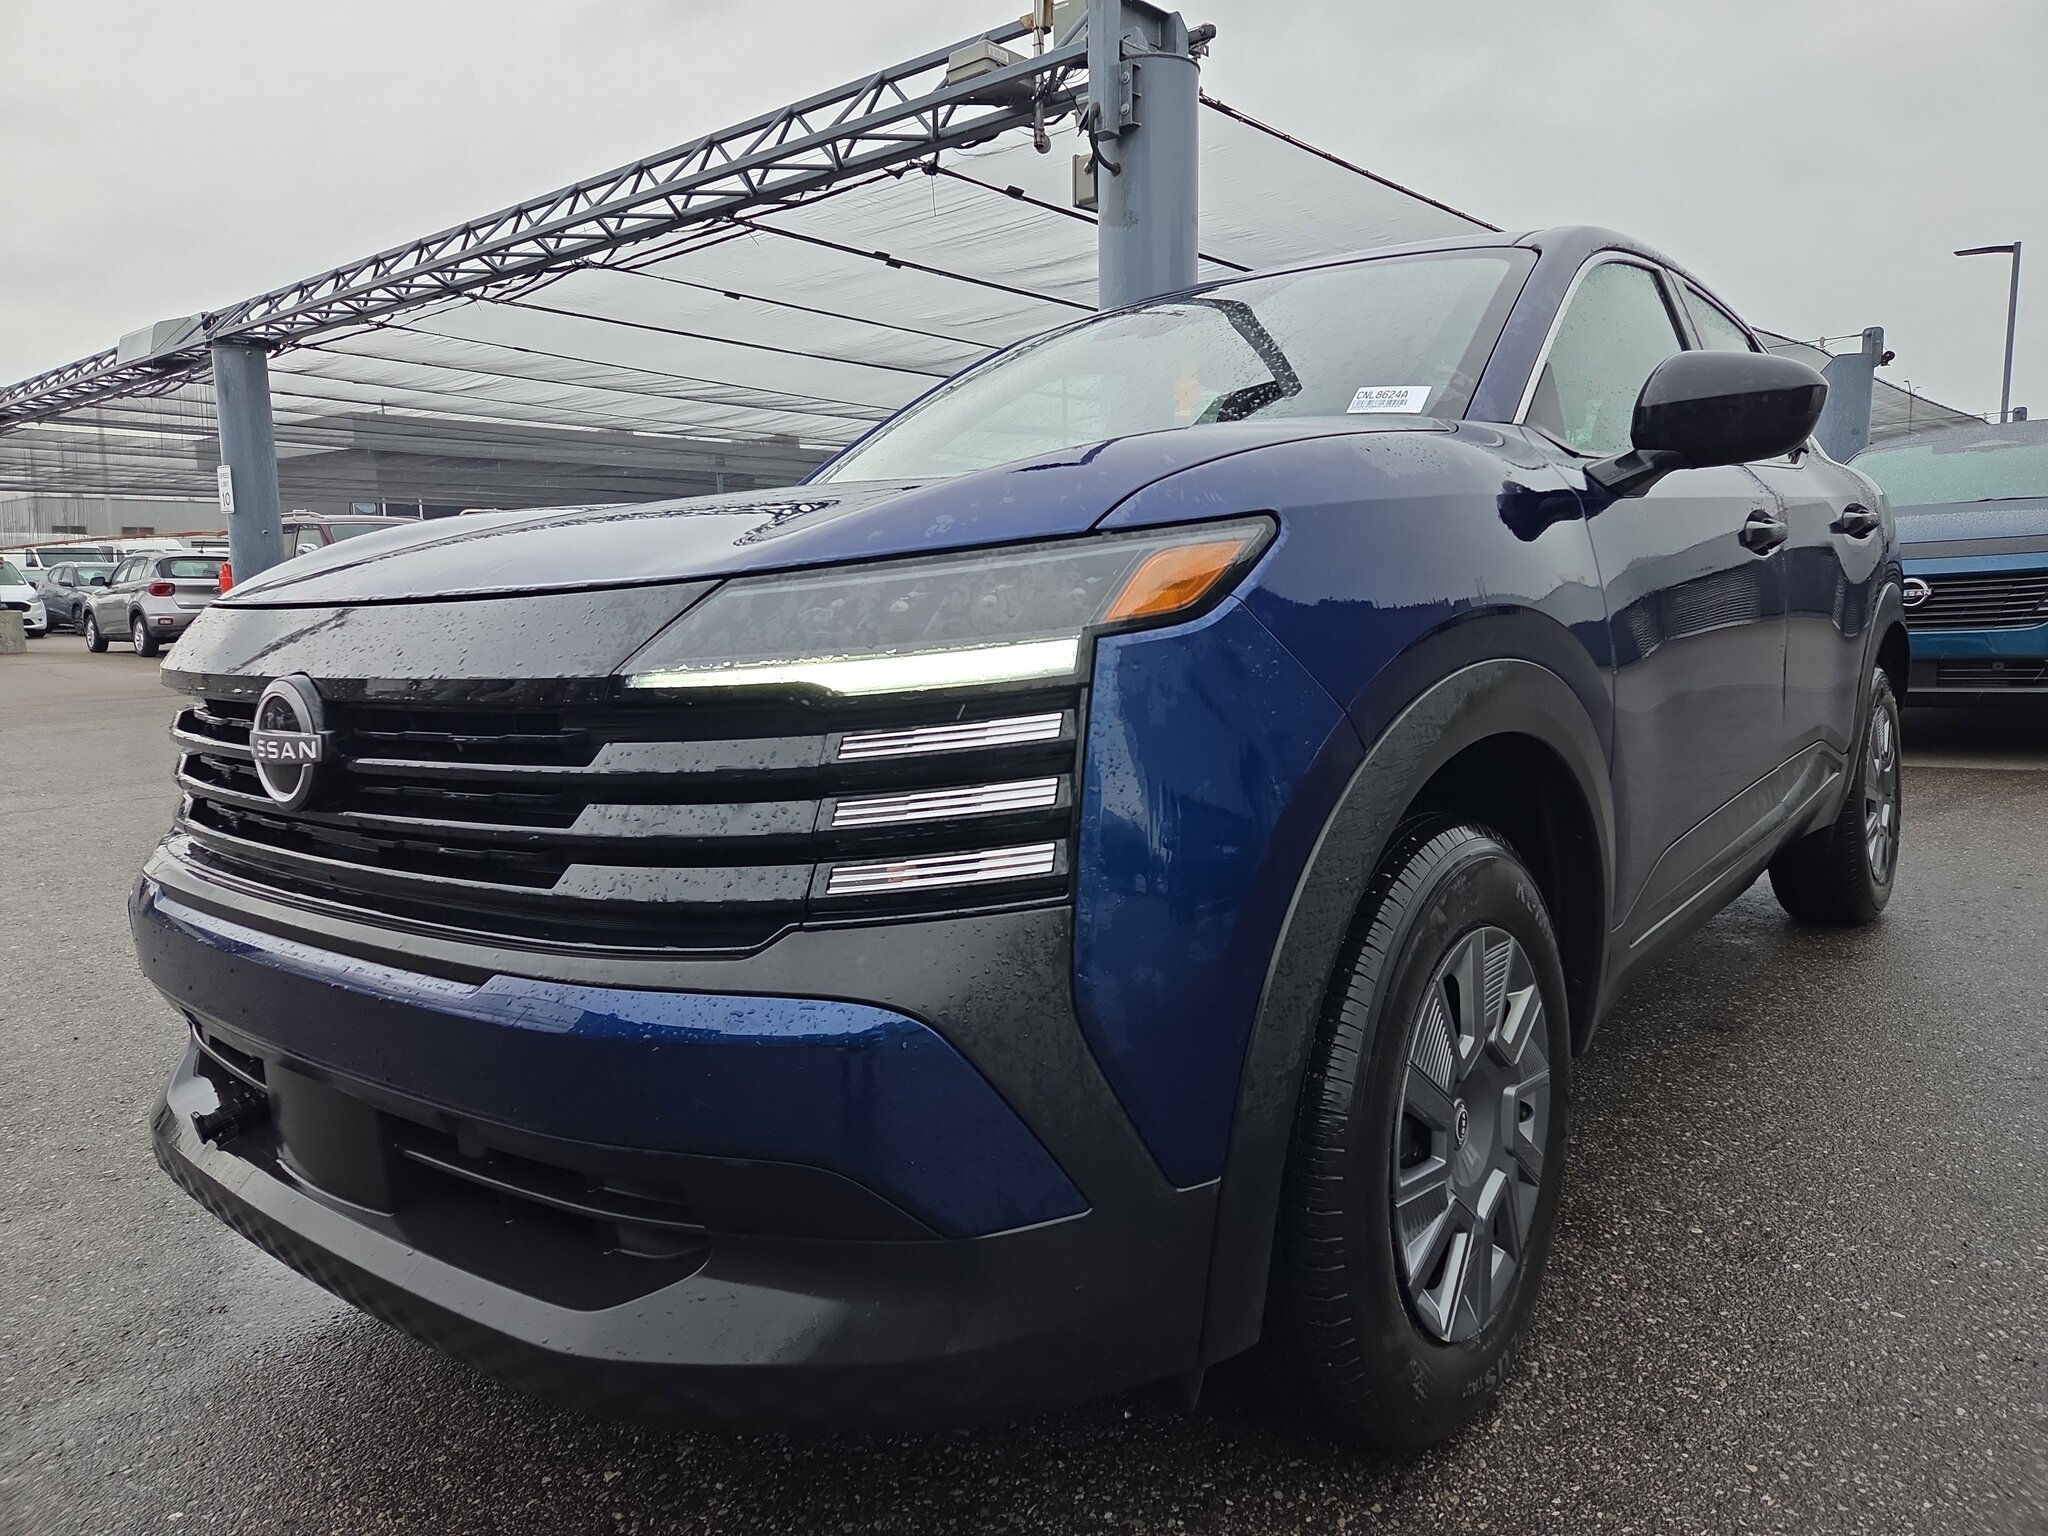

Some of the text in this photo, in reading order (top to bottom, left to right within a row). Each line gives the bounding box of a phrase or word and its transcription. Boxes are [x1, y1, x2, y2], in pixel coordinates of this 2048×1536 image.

[1356, 390, 1408, 399] CNL8624A
[221, 492, 230, 507] 10
[256, 739, 317, 759] SSAN
